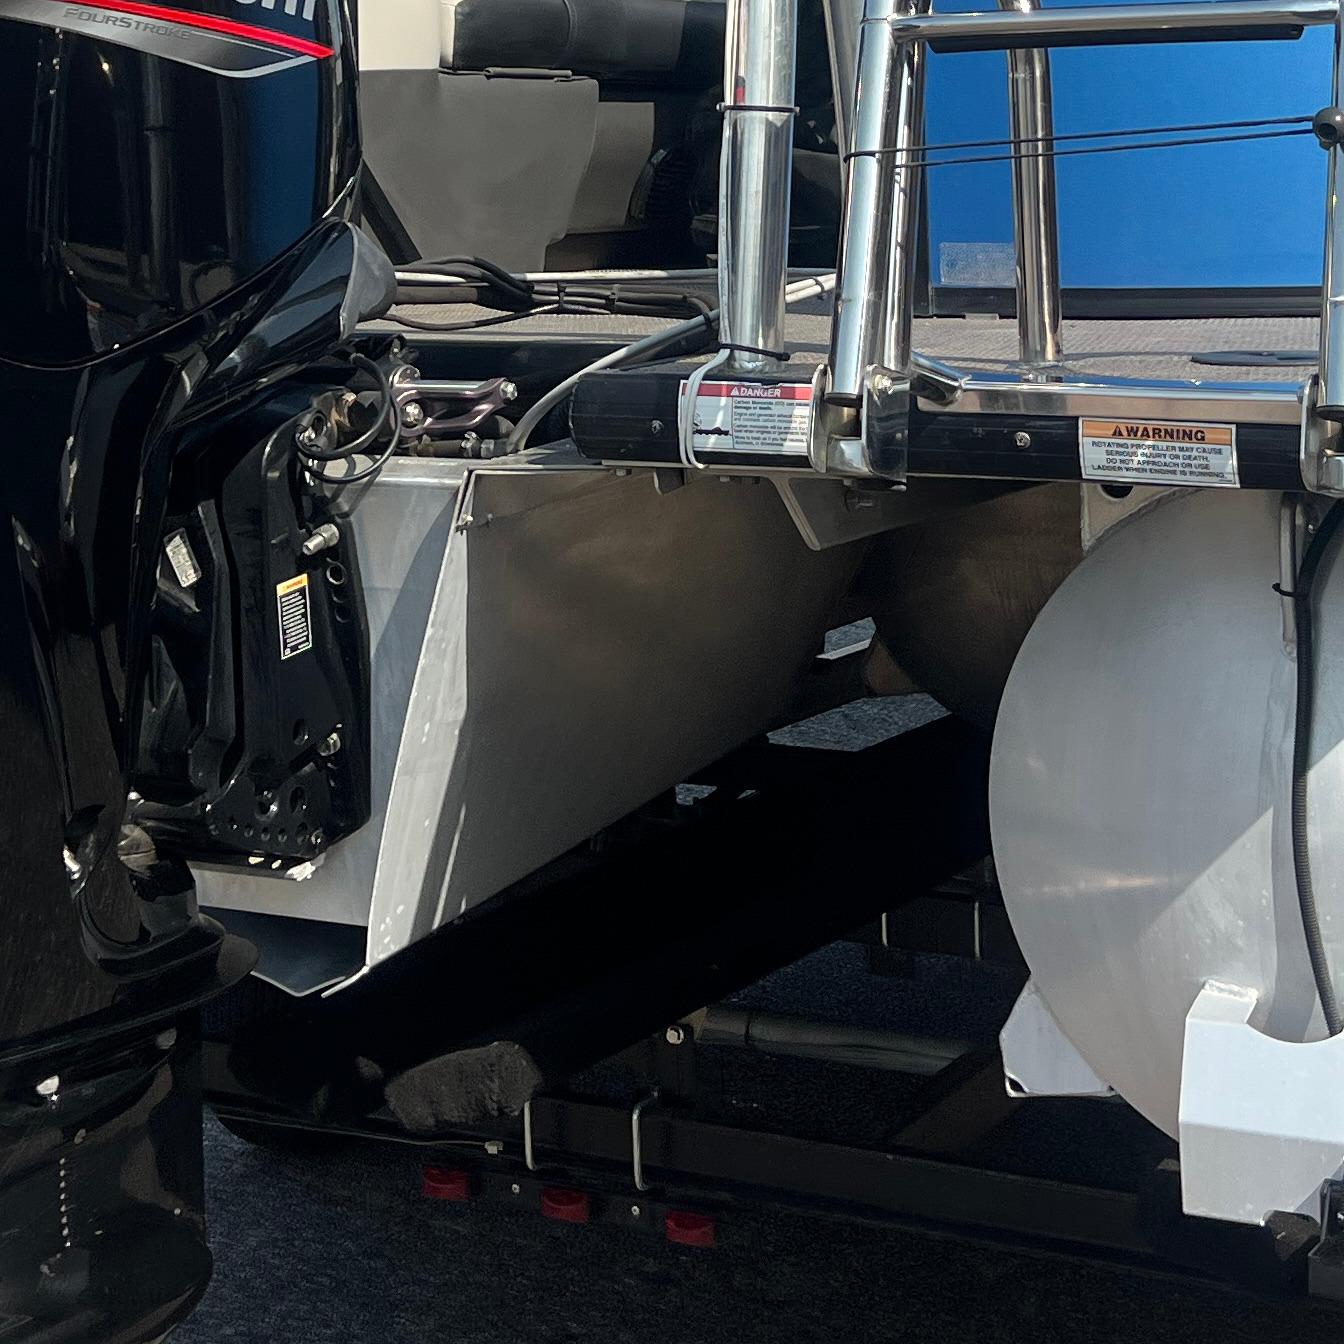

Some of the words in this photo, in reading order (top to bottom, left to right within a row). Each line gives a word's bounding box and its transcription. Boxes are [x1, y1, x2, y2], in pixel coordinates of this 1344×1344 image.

[740, 387, 781, 397] DANGER
[1125, 425, 1206, 442] WARNING
[1091, 440, 1129, 449] ROTATING
[1195, 447, 1223, 455] CAUSE
